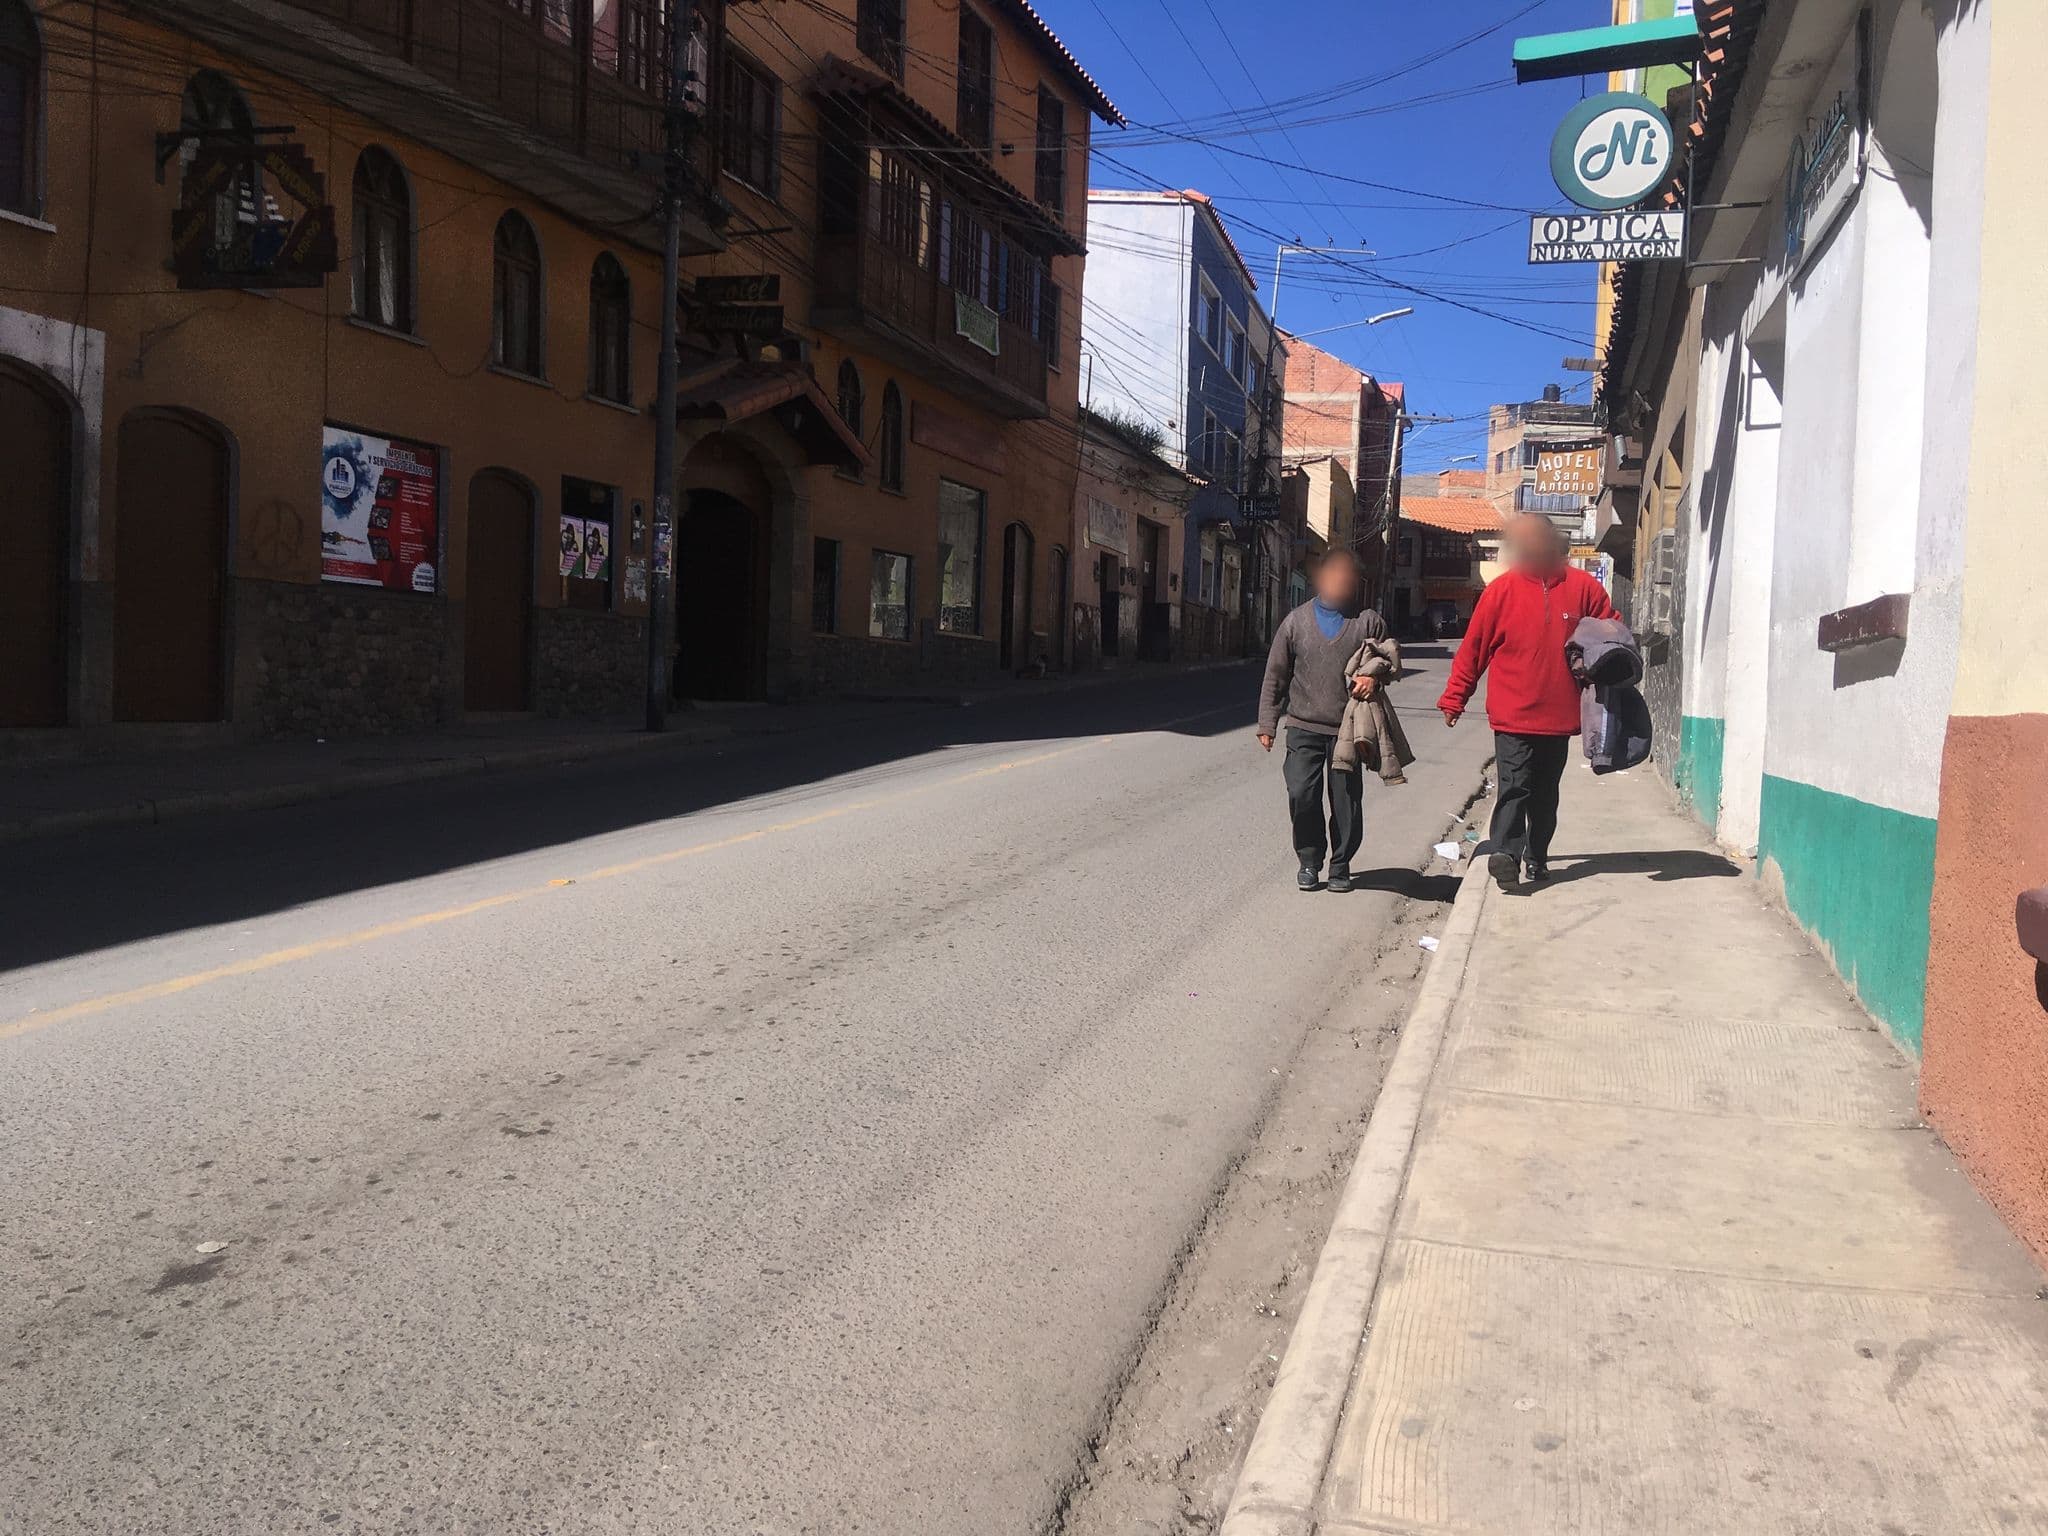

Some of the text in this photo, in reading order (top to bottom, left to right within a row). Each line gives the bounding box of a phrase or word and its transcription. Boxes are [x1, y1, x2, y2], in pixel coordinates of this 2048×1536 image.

[1579, 120, 1658, 181] Ni
[1543, 214, 1670, 242] OPTICA
[1534, 242, 1676, 259] NUEVA IMAGEN
[1541, 452, 1595, 473] HOTEL
[1553, 470, 1580, 482] San
[1538, 481, 1594, 492] Antonio
